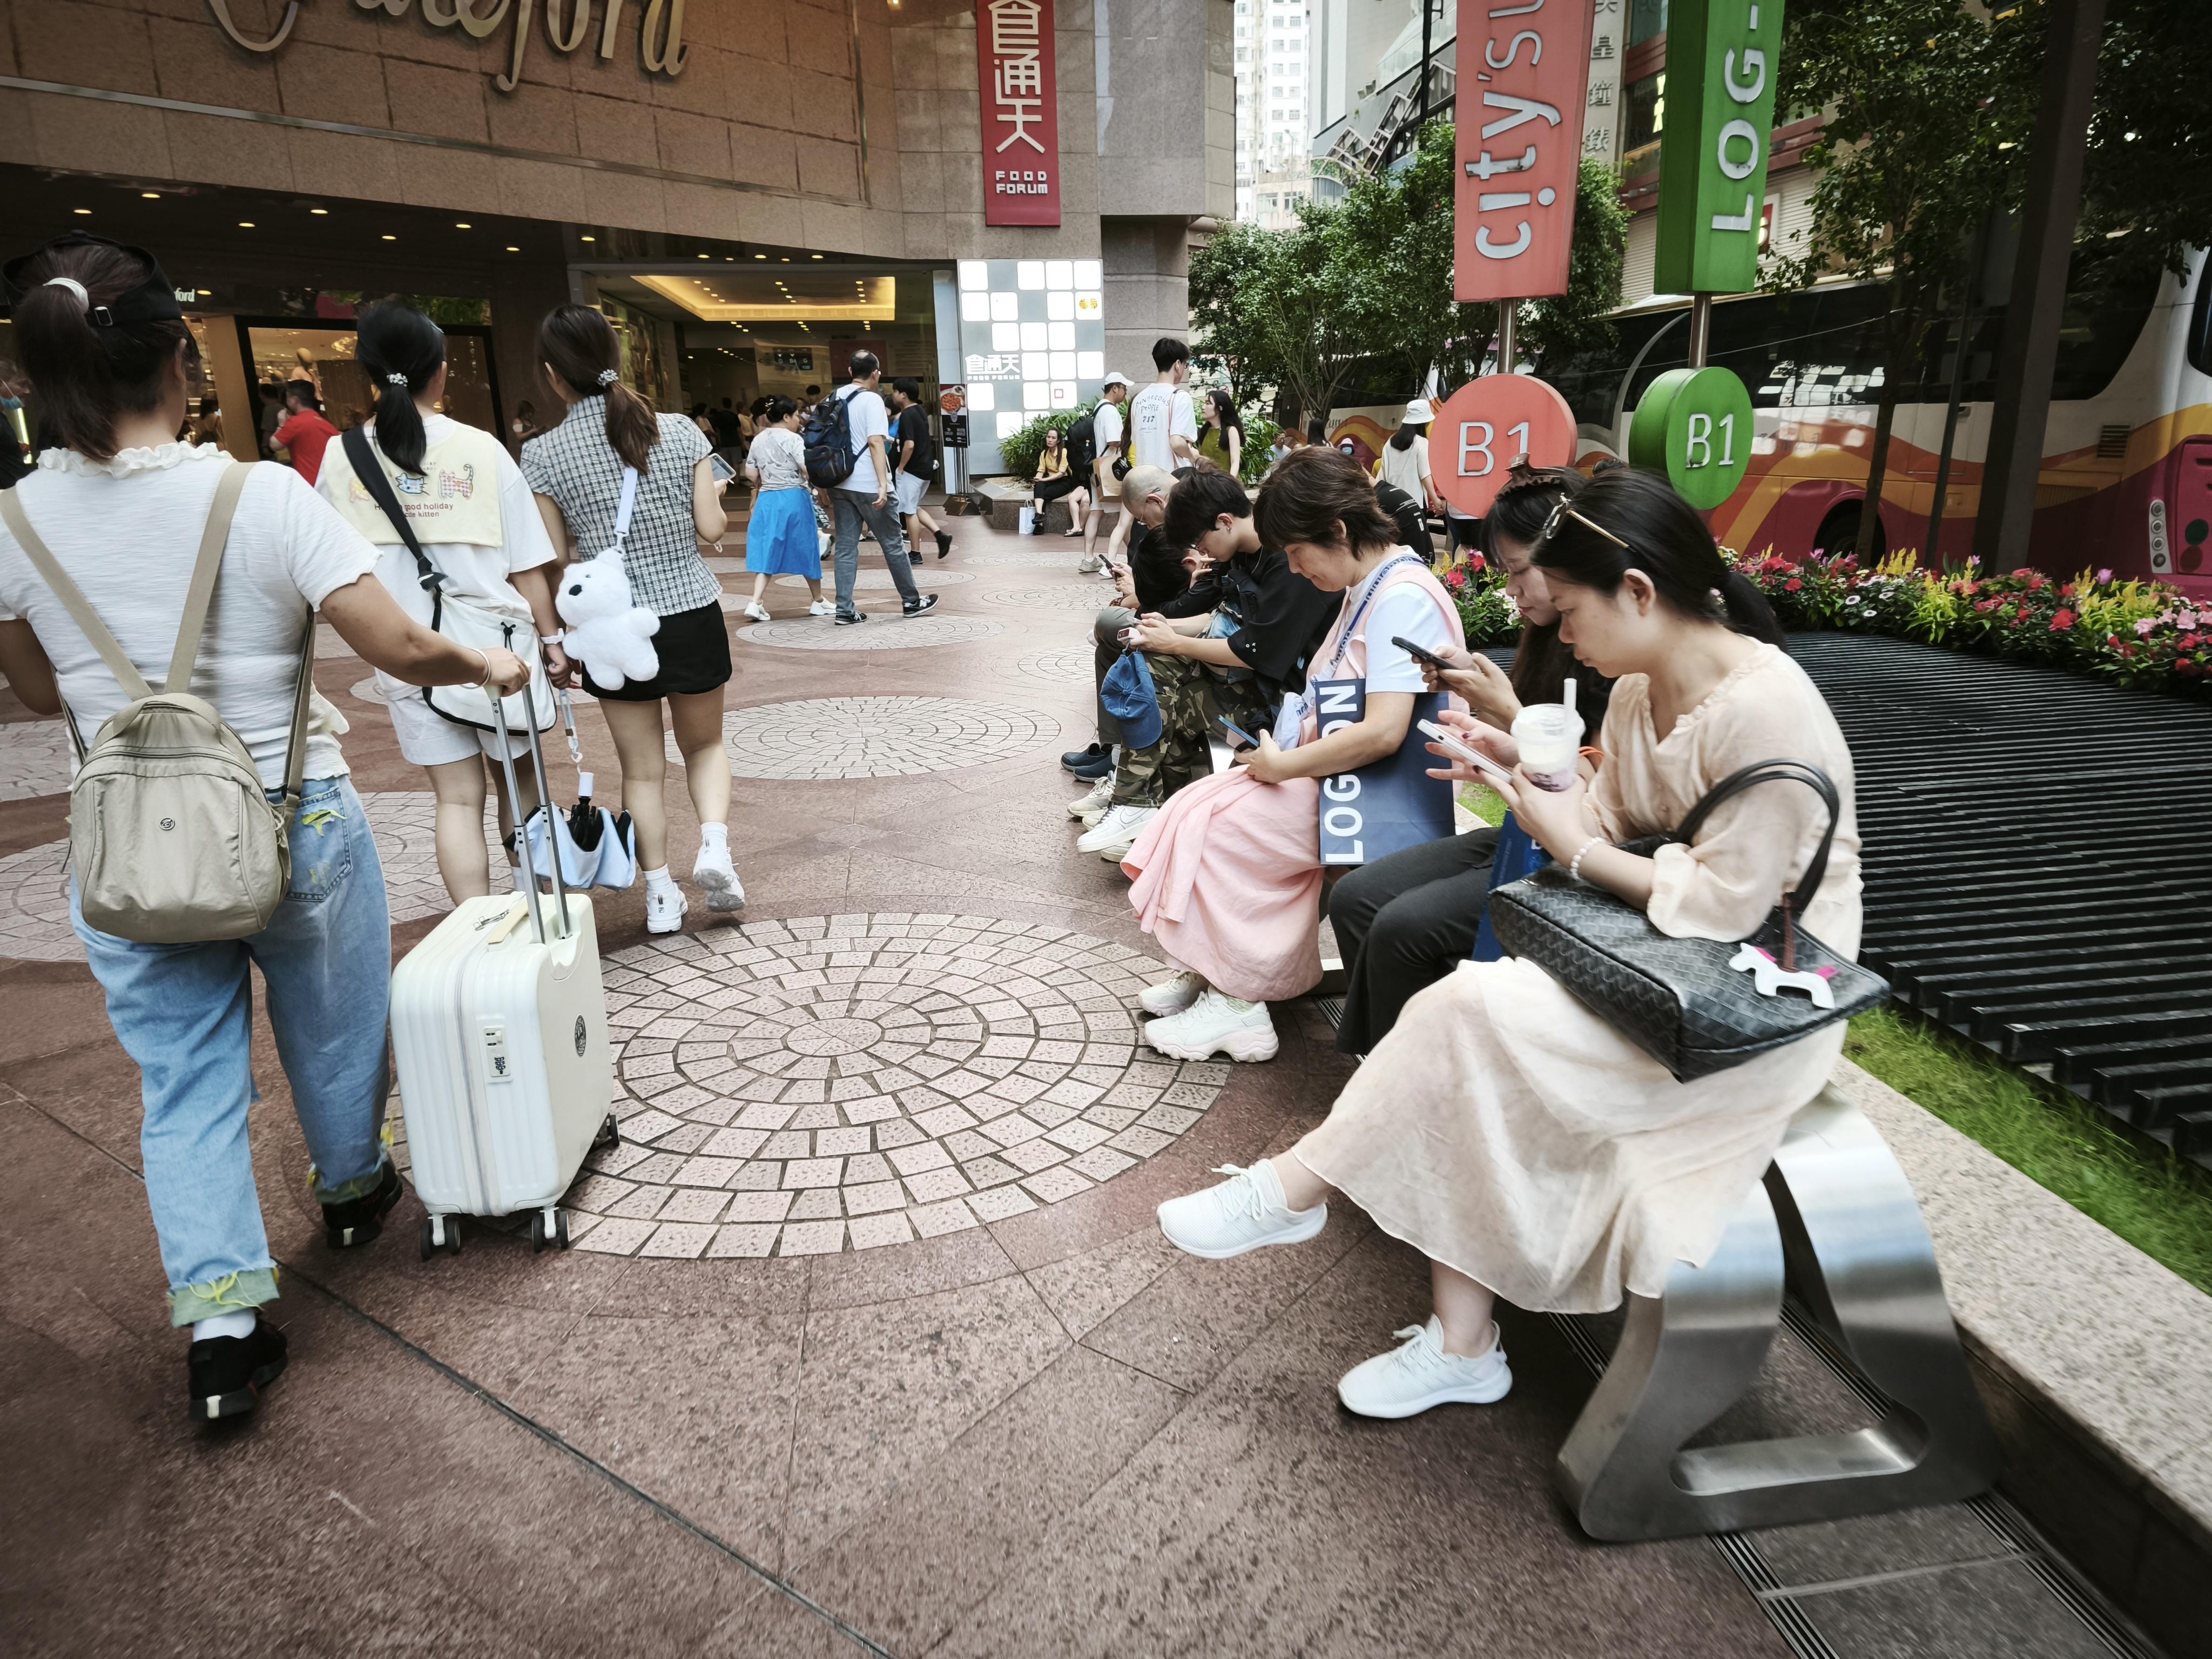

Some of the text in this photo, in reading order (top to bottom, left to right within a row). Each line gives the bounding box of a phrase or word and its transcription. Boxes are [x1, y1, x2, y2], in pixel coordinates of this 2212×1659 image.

[988, 0, 1046, 153] 食通天
[1711, 4, 1766, 231] LOG-
[995, 171, 1047, 181] FOOD
[996, 184, 1048, 194] FORUM
[173, 287, 195, 302] ford
[1458, 421, 1529, 476] B1
[1685, 413, 1734, 468] B1
